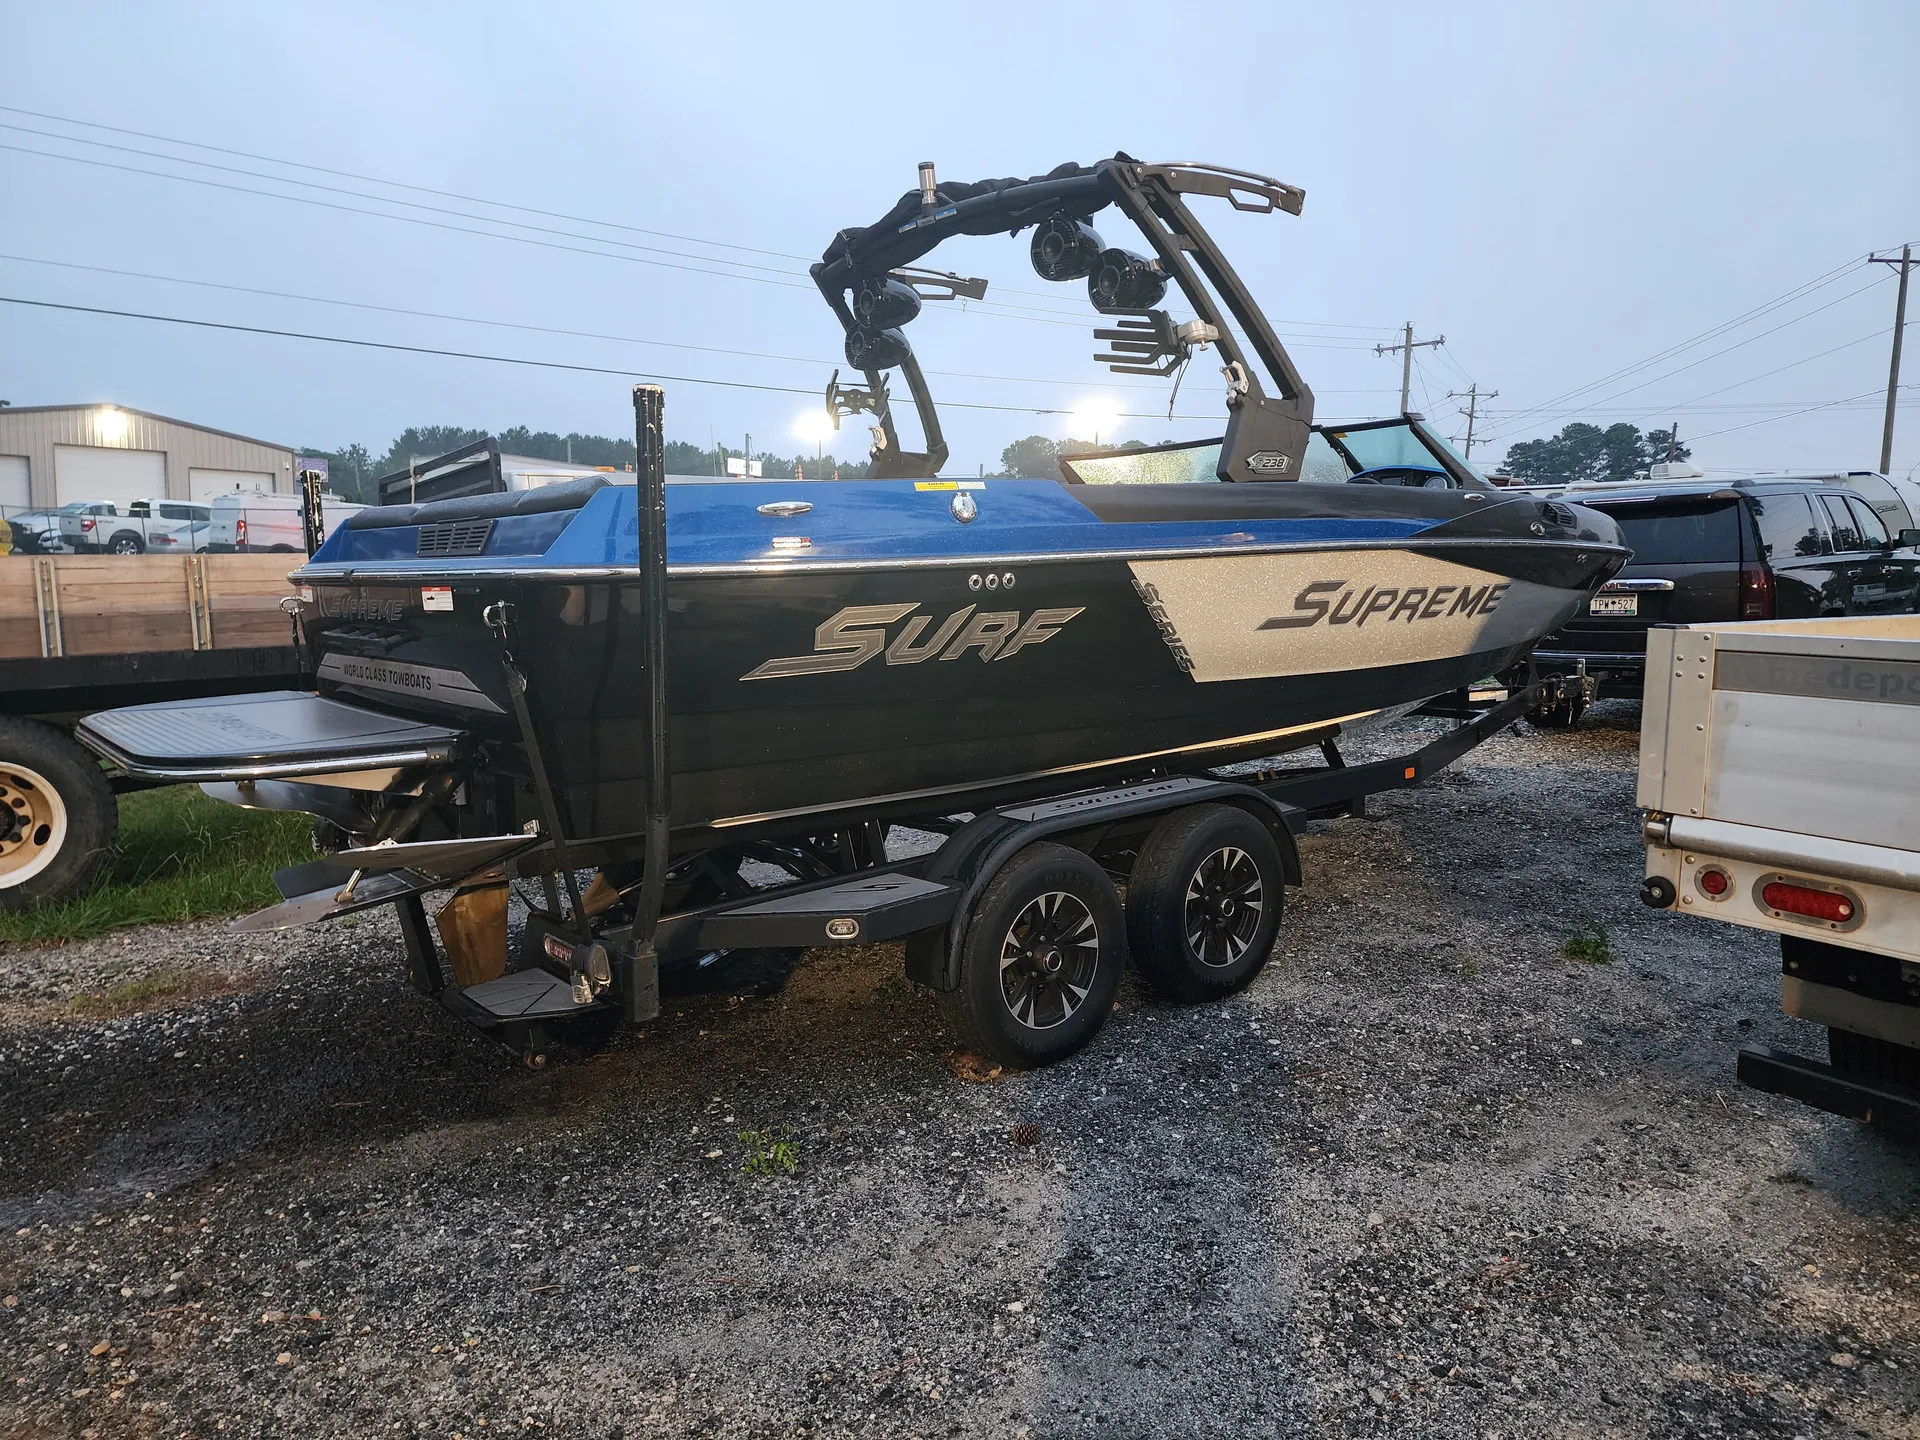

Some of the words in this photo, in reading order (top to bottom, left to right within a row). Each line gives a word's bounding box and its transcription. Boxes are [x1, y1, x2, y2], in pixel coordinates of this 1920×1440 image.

[328, 594, 405, 623] SUPREME
[1254, 579, 1512, 632] SUPREME
[1593, 599, 1609, 610] TPW
[1617, 599, 1634, 610] 527
[739, 602, 1087, 682] SURF
[1130, 579, 1197, 673] SERIES
[344, 664, 364, 679] WORLD
[365, 666, 387, 683] CLASS
[388, 670, 432, 691] TOWBOATS
